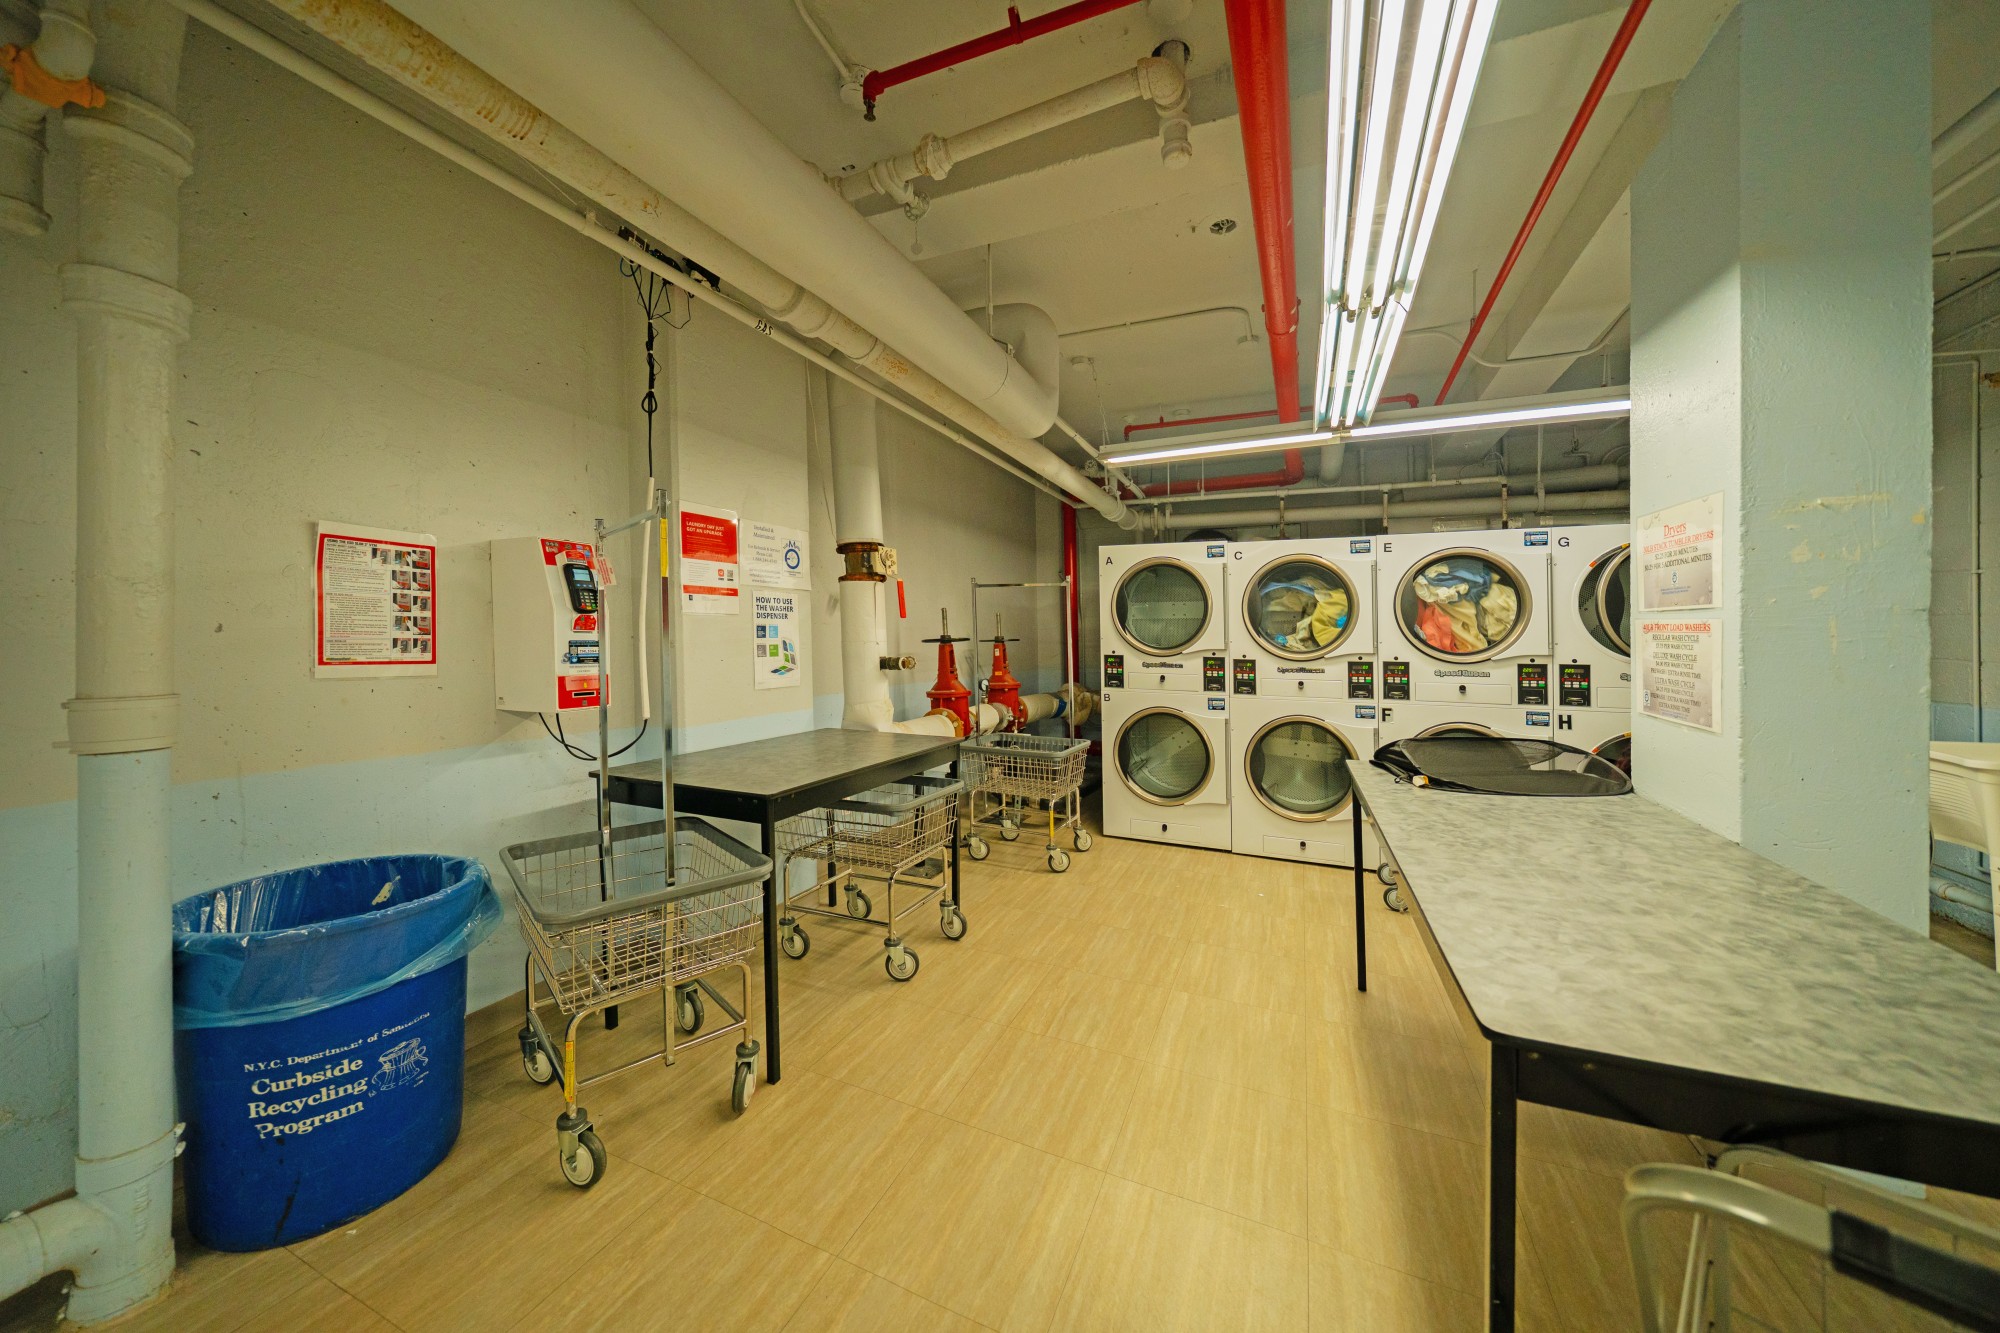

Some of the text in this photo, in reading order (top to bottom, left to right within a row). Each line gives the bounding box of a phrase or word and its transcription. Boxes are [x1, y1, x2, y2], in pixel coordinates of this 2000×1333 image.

[754, 319, 774, 336] GAS
[1663, 523, 1687, 538] Dryers
[1558, 537, 1570, 548] G
[1668, 535, 1692, 548] TUMBLER
[1692, 530, 1714, 542] DRYERS
[1384, 542, 1393, 553] E
[1678, 545, 1698, 555] MINUTES
[1106, 556, 1113, 566] A
[1234, 551, 1243, 561] C
[1664, 557, 1690, 568] ADDITIONAL
[1690, 553, 1712, 563] MINUTES
[756, 604, 794, 613] THE WASHER
[756, 612, 789, 620] DISPENSER
[1654, 623, 1670, 632] FRONT
[1670, 623, 1684, 632] LOAD
[1684, 623, 1711, 632] WASHERS
[1683, 634, 1700, 642] CYCLE
[1681, 653, 1698, 662] CYCLE
[1434, 669, 1462, 679] Speed
[1104, 693, 1111, 702] B
[1382, 708, 1393, 722] F
[1558, 714, 1572, 730] H
[243, 1059, 284, 1073] N.Y.C.
[367, 1032, 379, 1043] of
[250, 1058, 363, 1096] Curbside
[247, 1077, 369, 1119] Recycling
[255, 1101, 365, 1139] Program
